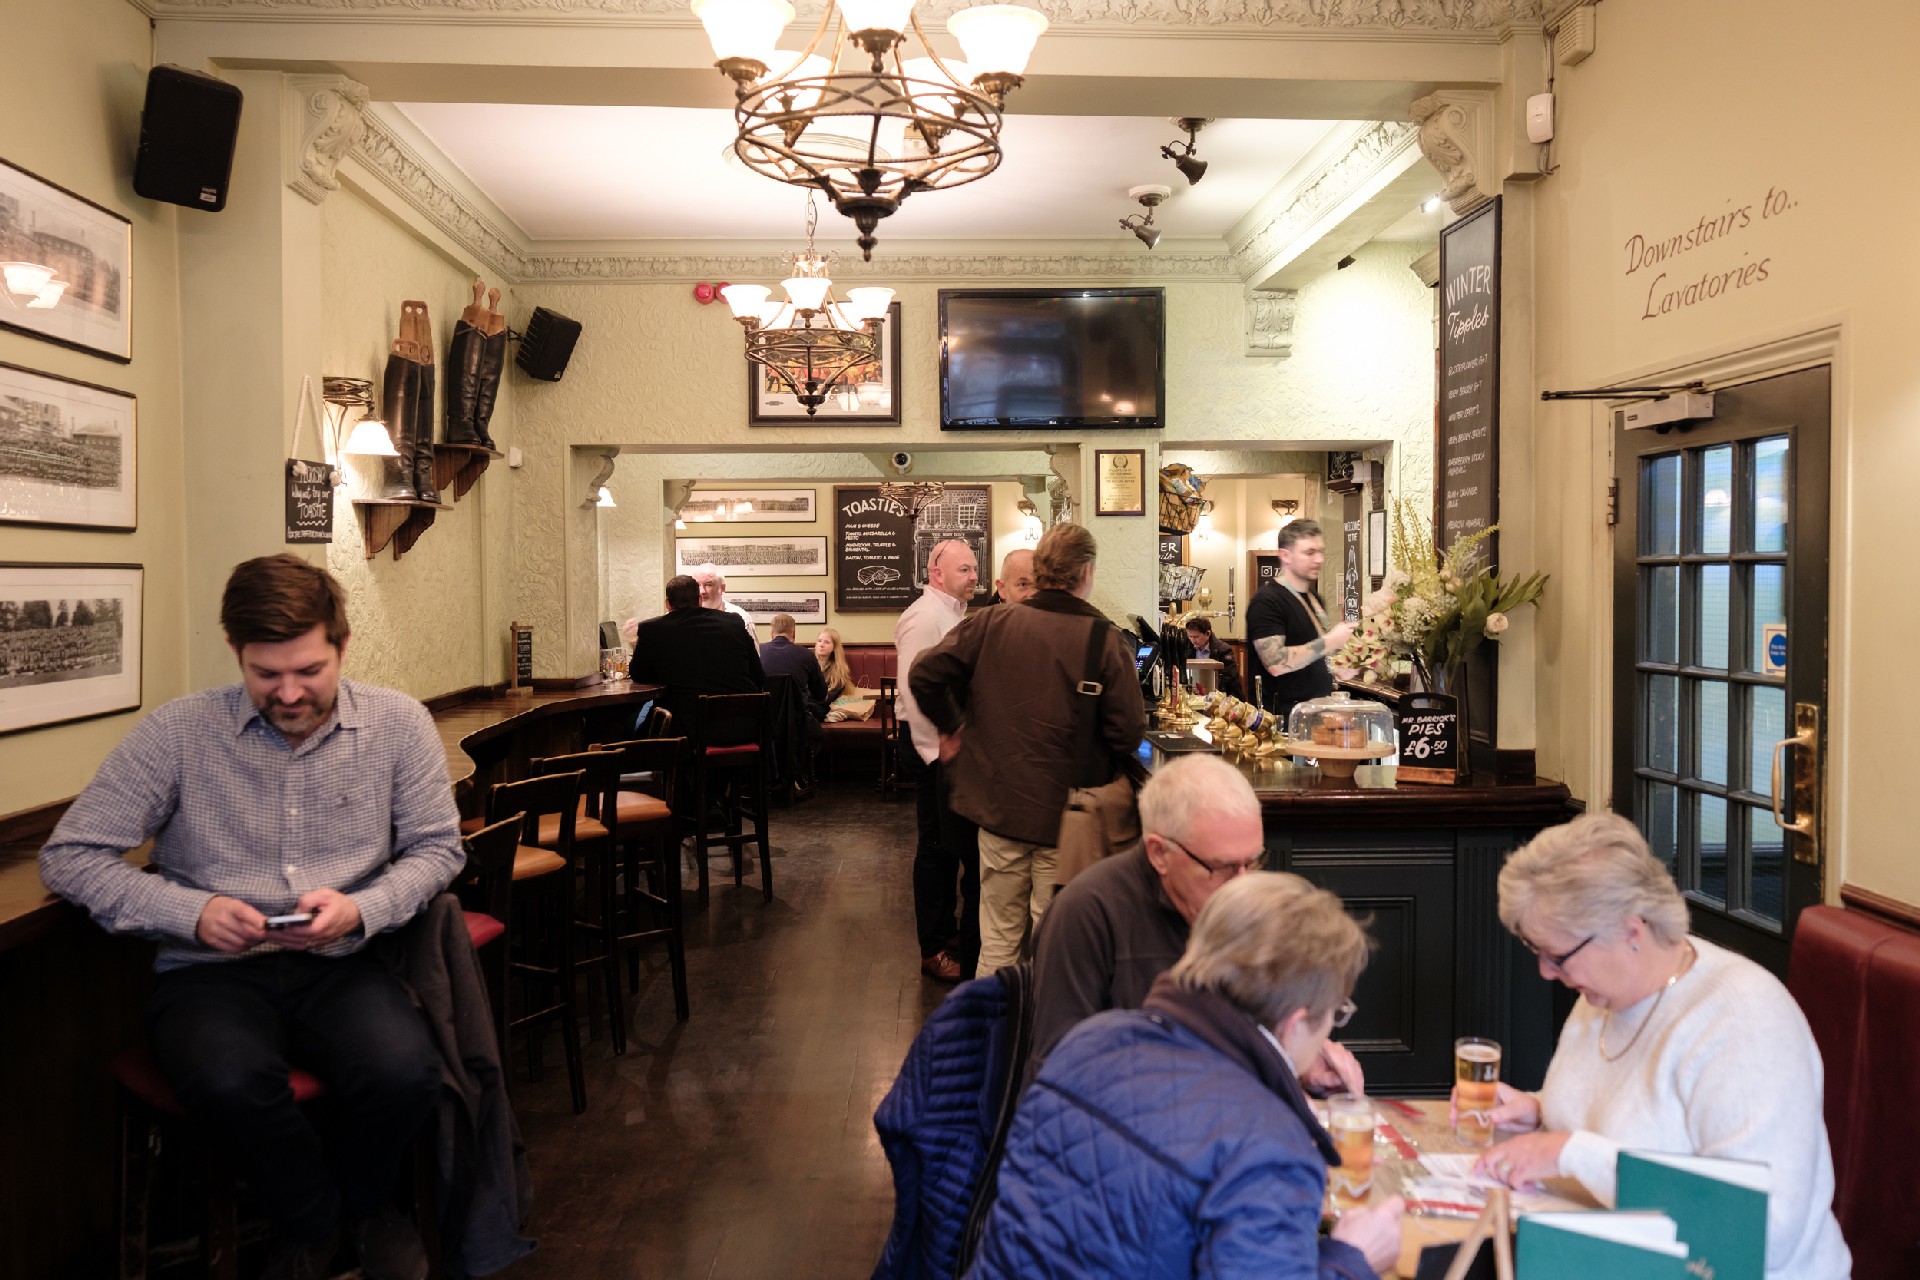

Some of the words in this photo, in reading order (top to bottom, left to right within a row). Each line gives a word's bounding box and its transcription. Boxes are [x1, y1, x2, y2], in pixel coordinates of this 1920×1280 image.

[1625, 199, 1752, 276] Downstairs
[1446, 264, 1491, 310] WINTER
[1642, 251, 1771, 320] Lavatories
[1447, 302, 1489, 344] Tipples
[297, 502, 327, 519] TOASTIE
[842, 498, 905, 518] TOASTIES
[1408, 723, 1445, 736] PIES
[1404, 736, 1448, 759] £6.50
